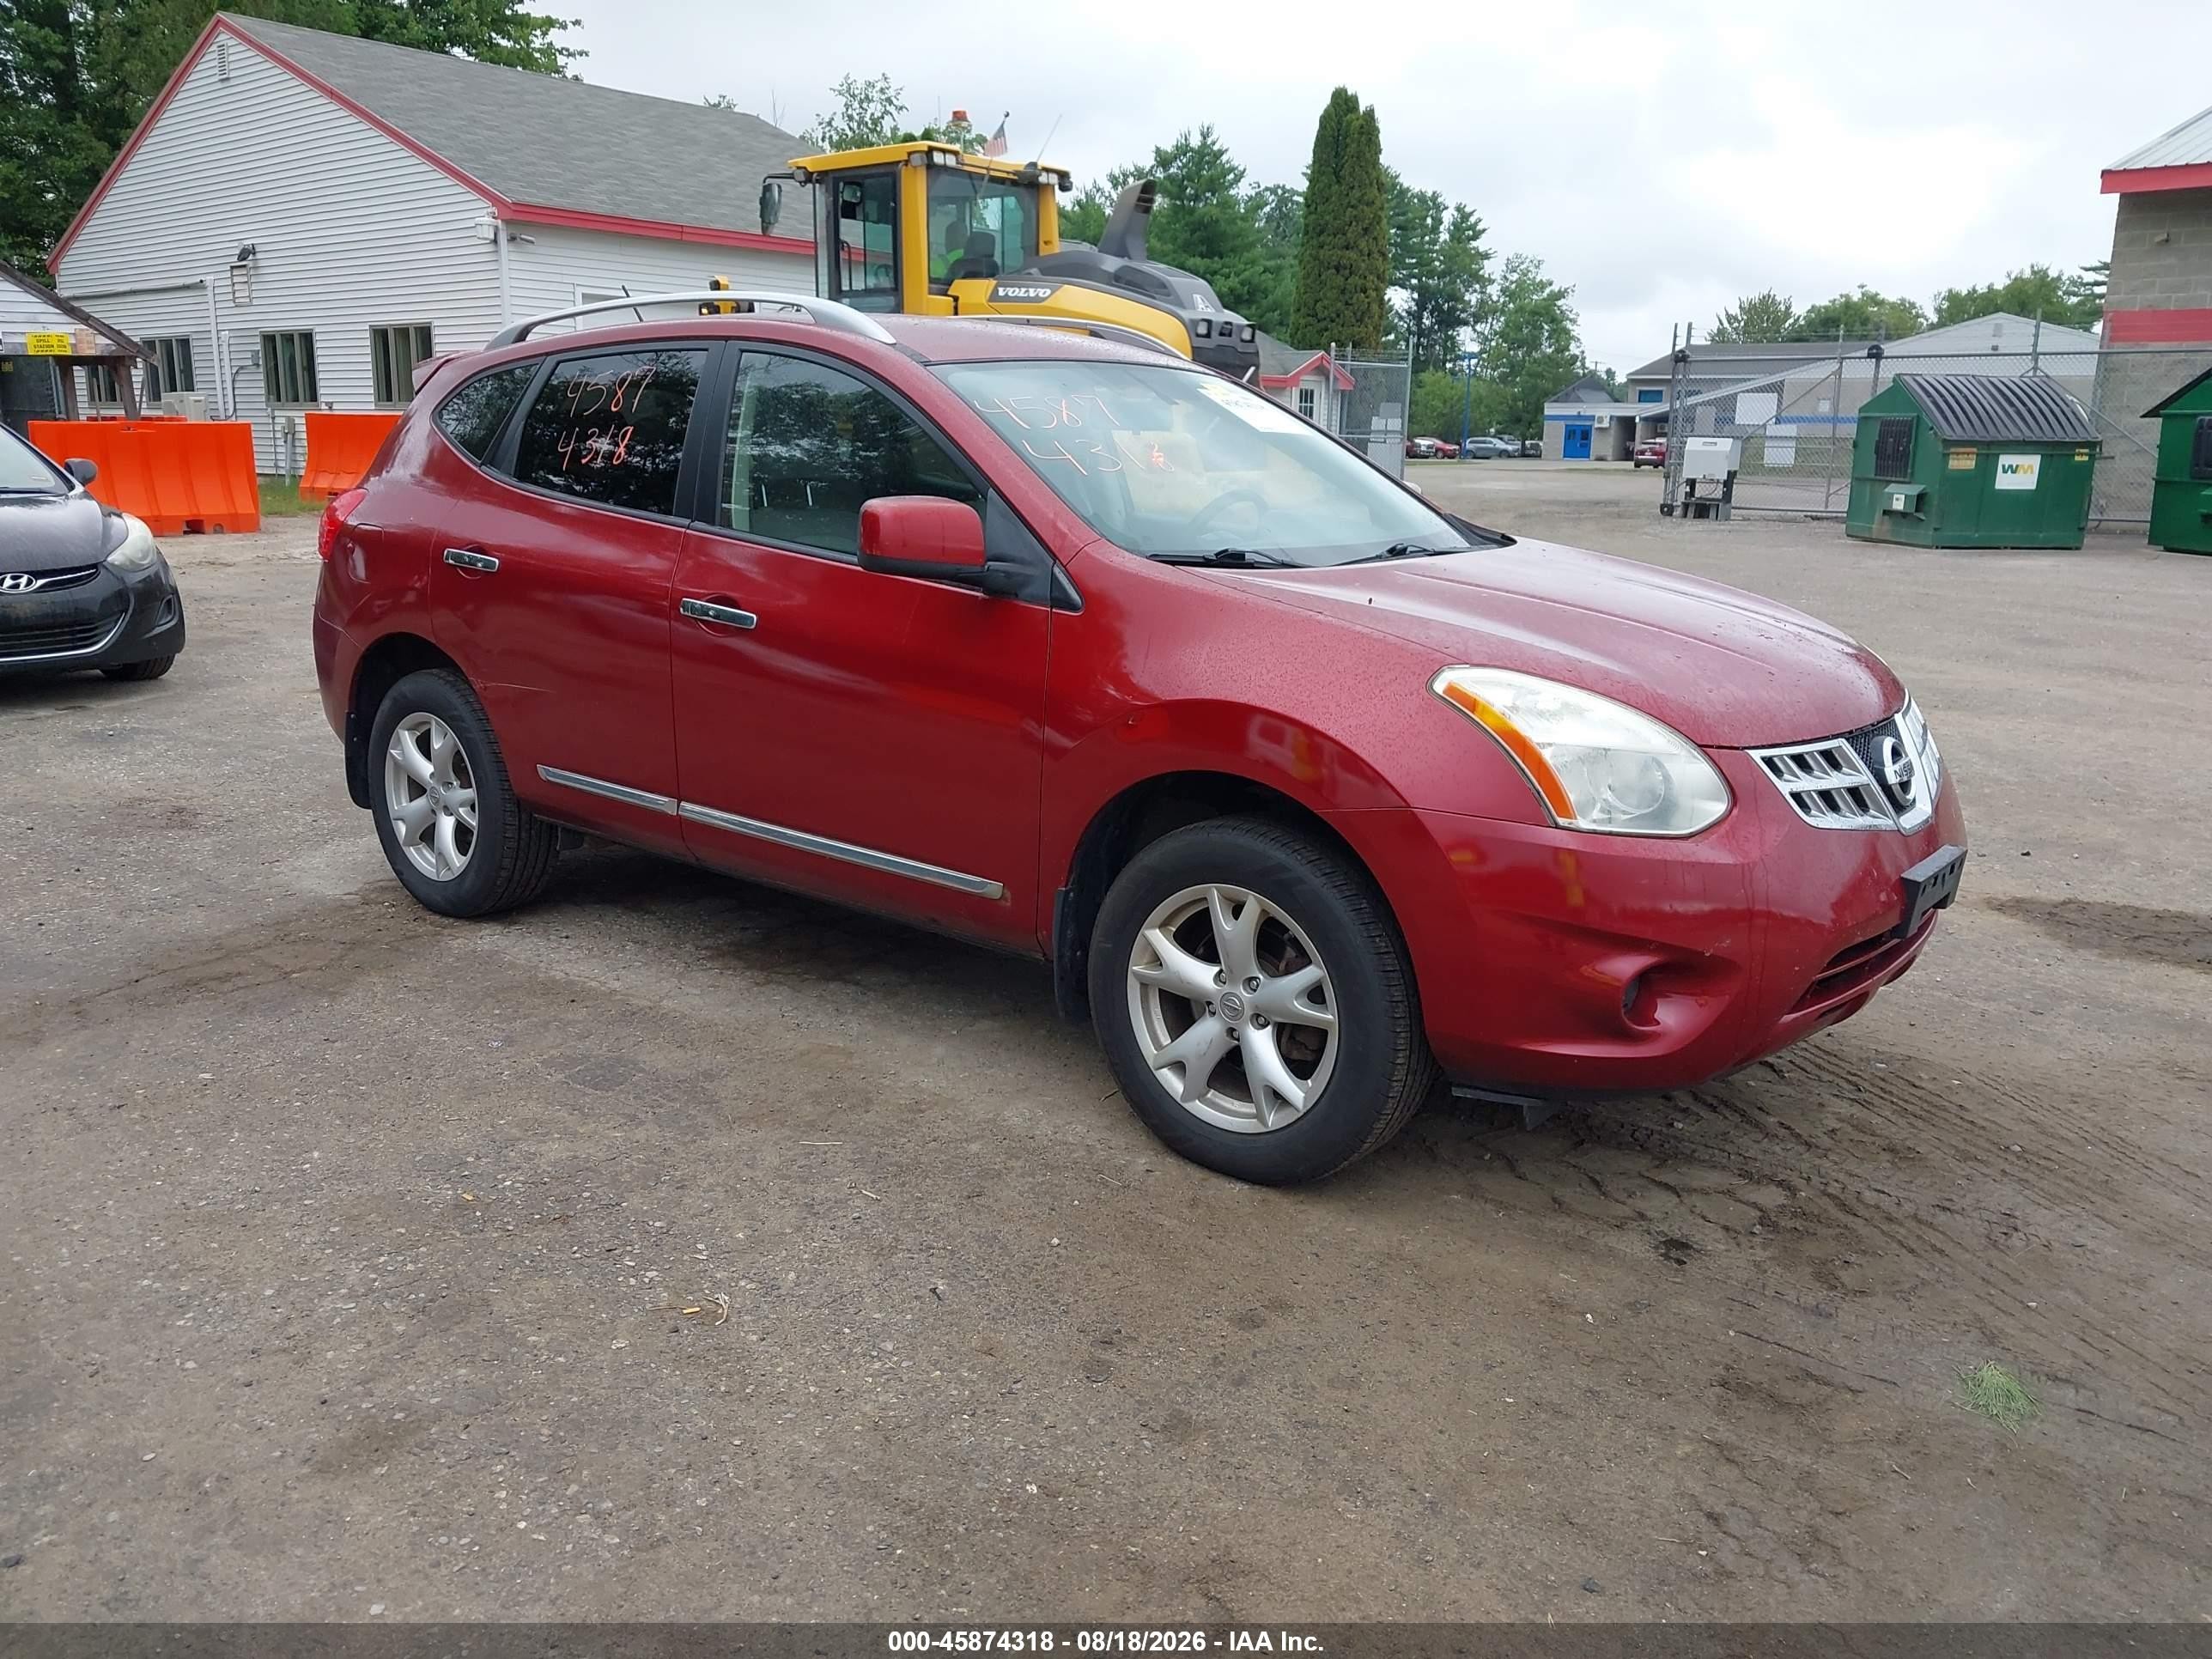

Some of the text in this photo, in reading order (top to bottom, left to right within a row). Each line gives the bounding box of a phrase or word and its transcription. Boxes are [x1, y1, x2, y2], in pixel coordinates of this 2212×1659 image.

[997, 287, 1052, 297] VOLVO
[567, 366, 656, 418] 4587
[973, 394, 1121, 430] 4587
[557, 424, 635, 471] 4318
[2002, 464, 2034, 475] WM
